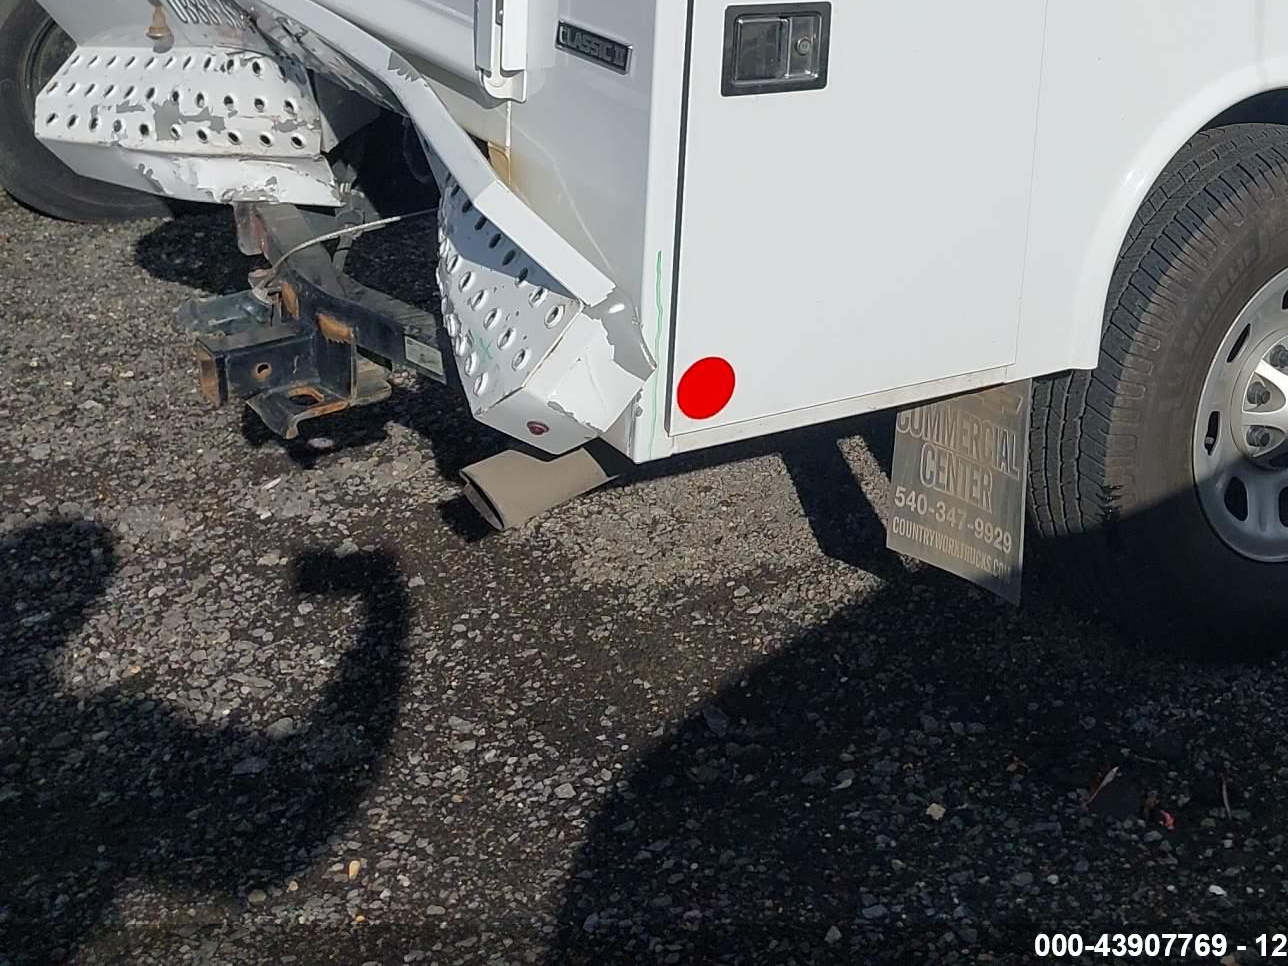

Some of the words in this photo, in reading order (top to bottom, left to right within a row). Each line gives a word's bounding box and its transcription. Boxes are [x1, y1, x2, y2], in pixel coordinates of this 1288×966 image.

[895, 403, 1021, 482] COMMERCIAL
[920, 440, 994, 515] CENTER
[893, 484, 1013, 555] 540-347-9929
